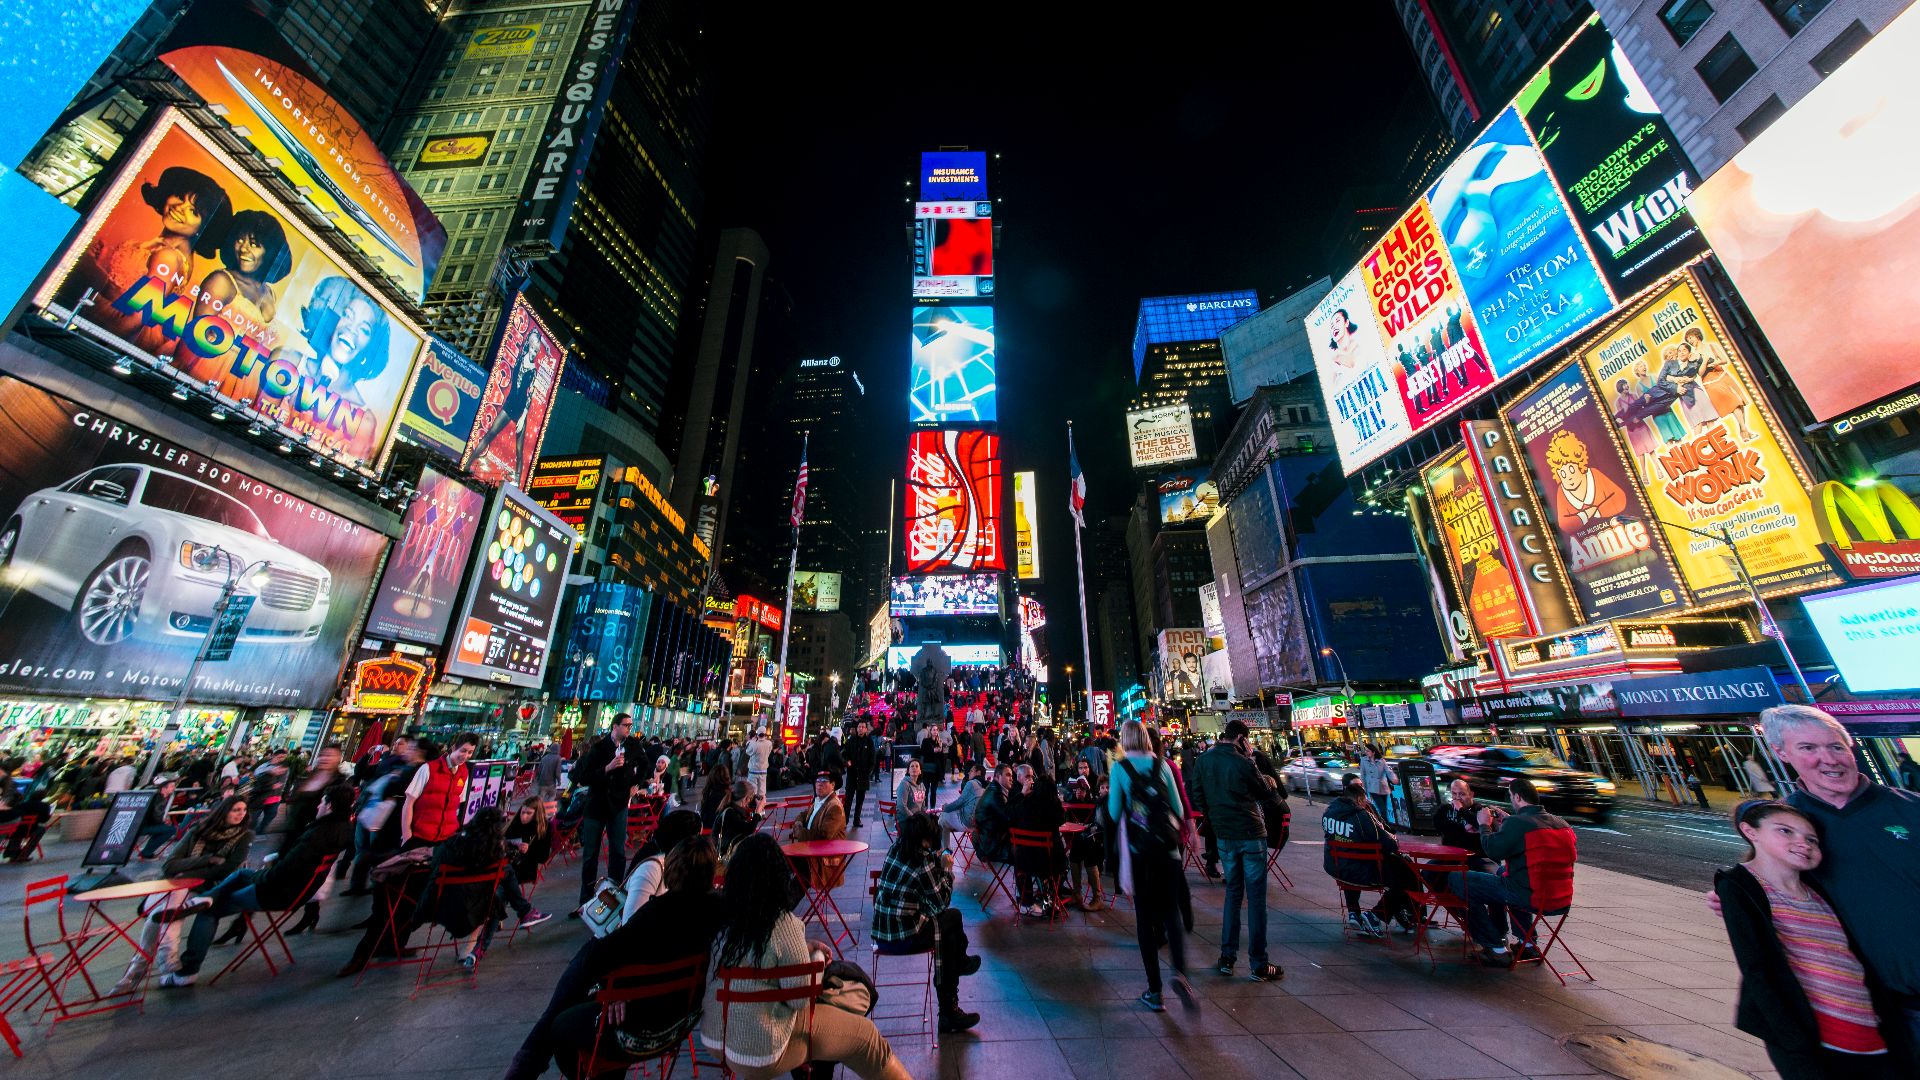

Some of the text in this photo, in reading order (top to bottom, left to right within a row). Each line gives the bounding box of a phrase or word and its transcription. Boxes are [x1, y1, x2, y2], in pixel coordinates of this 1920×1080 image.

[254, 68, 326, 145] IMPORTED
[329, 148, 361, 184] FROM
[533, 62, 598, 200] SQUARE
[1578, 154, 1630, 202] BIGGEST
[523, 218, 546, 226] NYC
[1500, 205, 1560, 256] Longest-Running
[1506, 204, 1545, 240] Broadway's
[1519, 227, 1547, 253] Musical
[1373, 233, 1435, 298] CROWD
[1506, 262, 1532, 284] The
[1378, 250, 1443, 318] GOES
[1482, 245, 1580, 326] PHANTOM
[156, 264, 278, 346] ON BROADWAY
[1200, 299, 1252, 311] BARCLAYS
[1506, 294, 1572, 343] OPERA
[1516, 288, 1550, 318] of the
[1653, 300, 1682, 326] Jessie
[1650, 307, 1698, 346] MUELLER
[112, 276, 365, 440] MOTOWN
[801, 359, 828, 368] Allianz
[1598, 334, 1634, 363] Matthew
[1598, 338, 1650, 382] BRODERICK
[422, 351, 480, 399] Avenue
[1406, 357, 1443, 400] JERSEY
[1442, 337, 1476, 376] BOYS
[260, 399, 290, 422] THE
[427, 379, 460, 426] Q
[1335, 367, 1388, 424] MAMMA
[1516, 383, 1584, 431] FEEL-GOOD MUSICAL
[1536, 382, 1567, 410] ULTIMATE
[1850, 394, 1920, 424] CLEAR CHANNEL
[1524, 426, 1548, 444] BETTER
[1546, 413, 1566, 432] THAN
[1530, 400, 1572, 432] IS BACK AND
[1154, 428, 1188, 438] MUSICAL
[1160, 434, 1190, 446] BEST
[540, 459, 602, 469] THOMSON REUTERS
[1136, 444, 1176, 456] MUSICAL
[1659, 424, 1738, 480] NICE
[73, 411, 360, 536] CHRYSLER 300 MOTOWN EDITION
[555, 477, 578, 485] INDICES
[1666, 450, 1766, 506] WORK
[423, 494, 474, 522] JOIN US
[1442, 486, 1485, 522] HANDS
[1485, 430, 1552, 583] PALACE
[1687, 488, 1764, 522] If You Can Get It
[1453, 506, 1495, 546] HARD
[1577, 520, 1610, 538] THE MUSICAL
[1690, 514, 1798, 554] New Comedy
[1692, 504, 1782, 540] The Tony-Winning
[396, 520, 466, 586] PIPPIN
[1460, 534, 1500, 564] BODY
[1571, 516, 1650, 572] Annie
[1588, 566, 1649, 588] TICKETMASTER.COM
[464, 630, 488, 654] CNN
[1166, 630, 1204, 644] men
[1168, 644, 1177, 653] at
[1630, 629, 1676, 648] Annie
[1845, 627, 1875, 641] this
[0, 658, 96, 680] sler.com
[1490, 700, 1506, 710] BOX
[1507, 697, 1532, 708] OFFICE
[1620, 682, 1770, 706] MONEY EXCHANGE
[1846, 704, 1875, 712] SQUARE
[1875, 702, 1912, 711] MUSEUM
[140, 709, 200, 729] SLM
[788, 696, 804, 727] tkts
[1094, 694, 1110, 726] tkts
